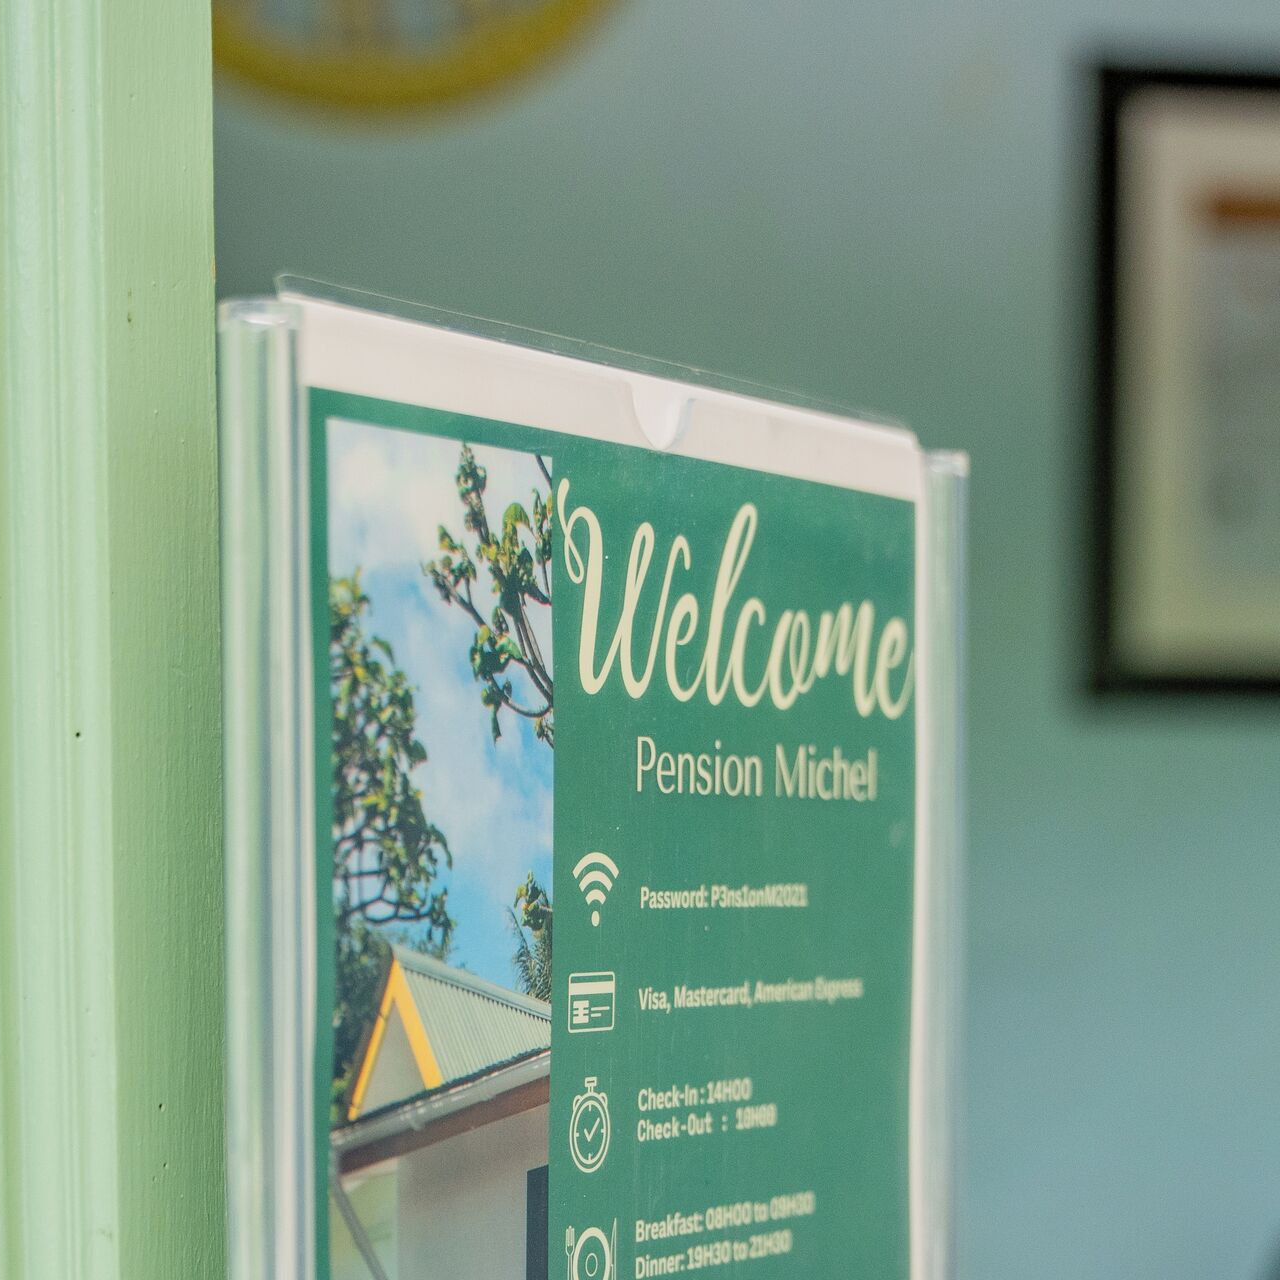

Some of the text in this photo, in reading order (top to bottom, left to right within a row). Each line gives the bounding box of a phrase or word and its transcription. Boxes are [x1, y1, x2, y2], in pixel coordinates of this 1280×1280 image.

[557, 478, 914, 719] Welcome
[636, 736, 878, 802] Pension Michel
[640, 884, 708, 909] Password:
[639, 976, 863, 1013] Visa, Mastercard, American Express
[637, 1111, 712, 1141] Check-Out
[635, 1212, 703, 1242] Breakfast:
[705, 1201, 752, 1230] 08H00
[753, 1202, 769, 1222] to
[635, 1229, 792, 1279] Dinner: 19H30 to 21H30
